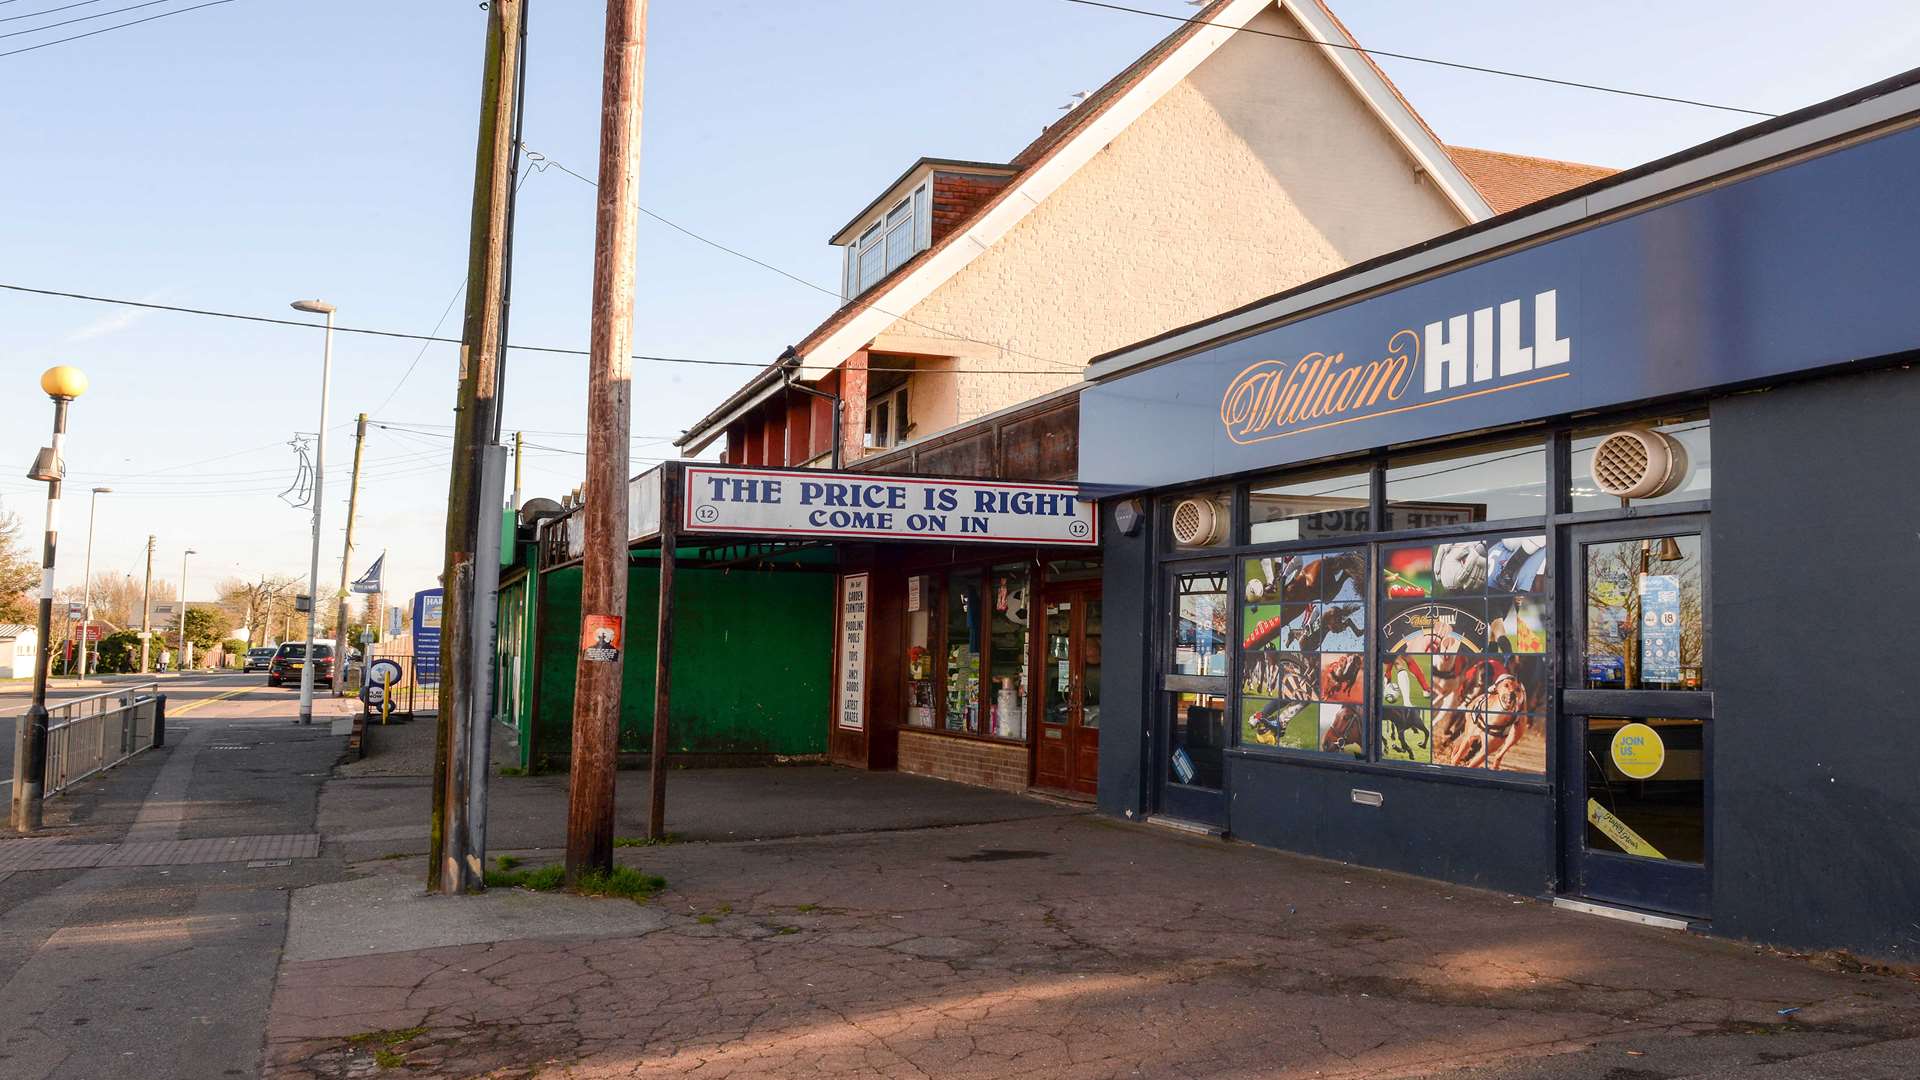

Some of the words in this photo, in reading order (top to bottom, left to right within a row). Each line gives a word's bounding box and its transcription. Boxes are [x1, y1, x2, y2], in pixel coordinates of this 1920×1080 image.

[1220, 329, 1420, 438] William
[1424, 289, 1571, 394] HILL
[707, 476, 782, 504] THE
[799, 481, 907, 511] PRICE
[923, 487, 959, 513] IS
[973, 489, 1080, 518] RIGHT
[700, 508, 714, 520] 12
[808, 509, 893, 531] COME
[906, 513, 947, 533] ON
[960, 516, 989, 534] IN
[1072, 523, 1086, 535] 12
[847, 632, 860, 643] POOLS
[846, 681, 859, 693] GOODS
[844, 699, 859, 711] LATEST
[844, 711, 859, 723] CRAZES
[1620, 736, 1645, 746] JOIN
